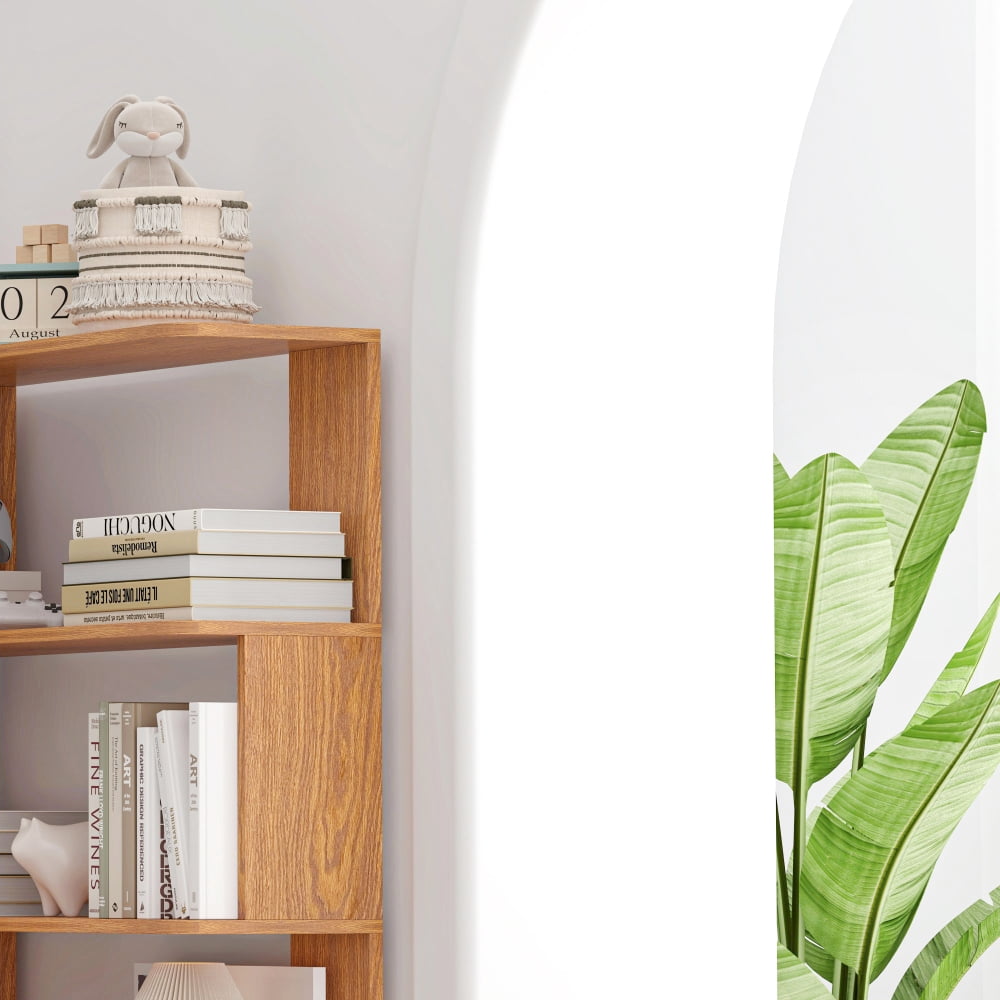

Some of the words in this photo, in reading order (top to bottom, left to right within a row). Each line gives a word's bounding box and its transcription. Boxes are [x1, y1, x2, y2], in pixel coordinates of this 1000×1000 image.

[50, 285, 70, 319] 2
[9, 328, 60, 340] August
[103, 512, 176, 537] NOGUCHI
[112, 540, 158, 556] Remodelista
[85, 590, 100, 608] CAFÉ
[100, 589, 108, 605] LE
[109, 588, 122, 604] FOIS
[122, 587, 134, 603] UNE
[135, 586, 151, 604] ÉTAIT
[151, 586, 158, 601] IL
[90, 741, 100, 796] FINE
[123, 753, 131, 788] ART
[189, 753, 198, 787] ART
[90, 808, 100, 890] WINES
